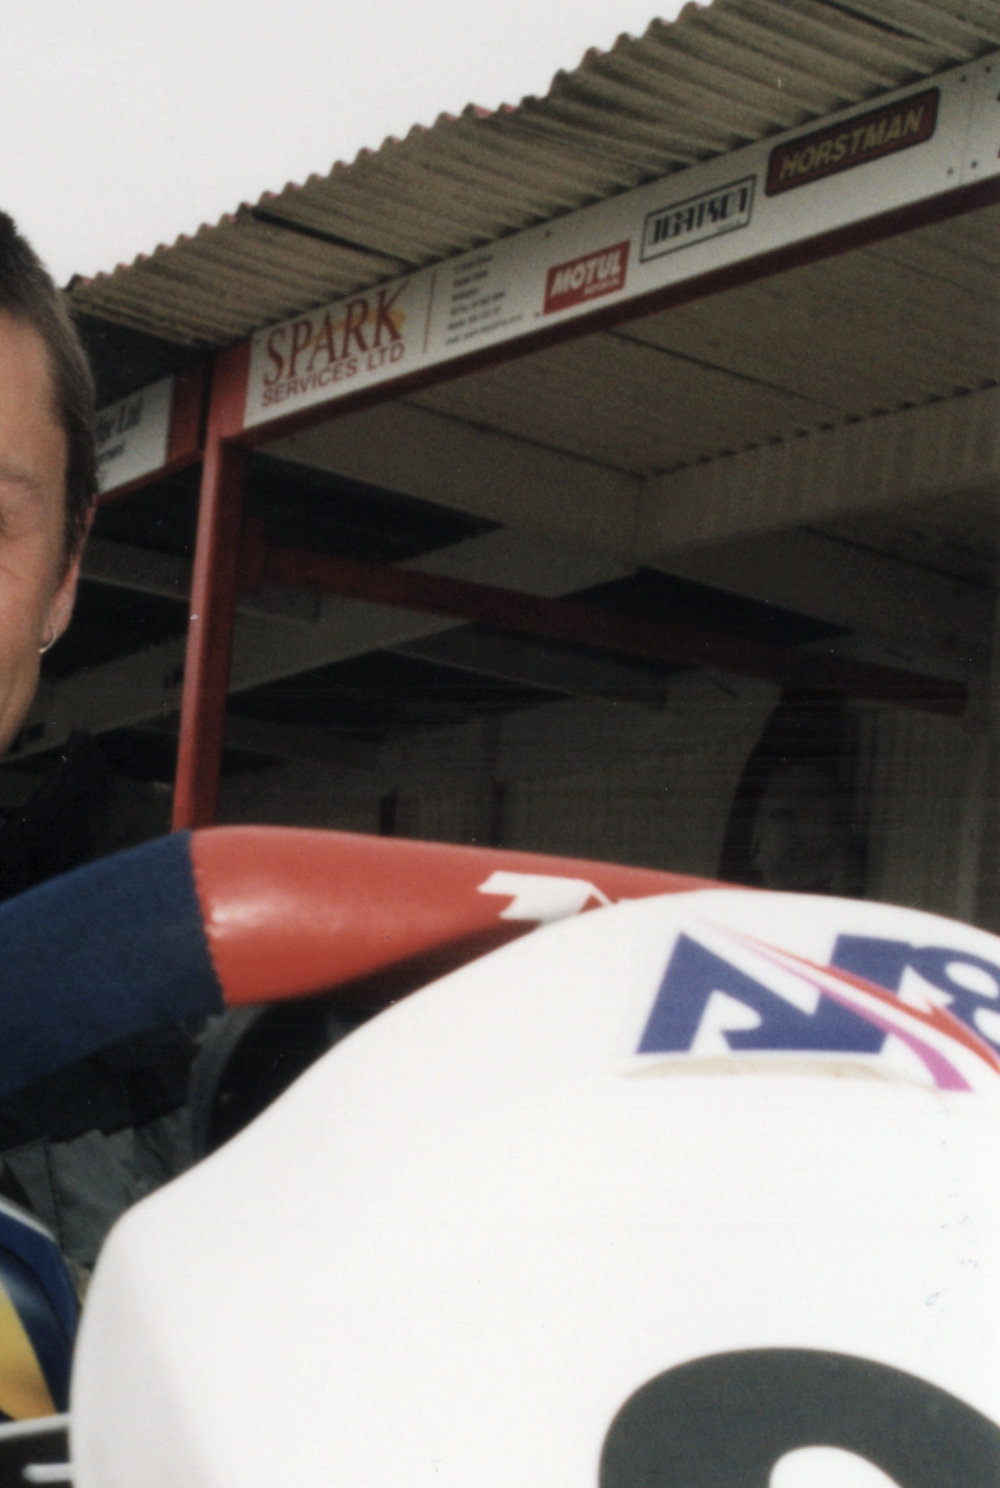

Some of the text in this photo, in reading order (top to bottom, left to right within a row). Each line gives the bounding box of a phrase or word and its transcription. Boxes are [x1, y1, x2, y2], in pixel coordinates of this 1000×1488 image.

[778, 105, 926, 181] HORSTMAN
[550, 250, 623, 298] MOTUL
[262, 280, 408, 387] SPARK
[260, 341, 406, 408] SERVICES LTD
